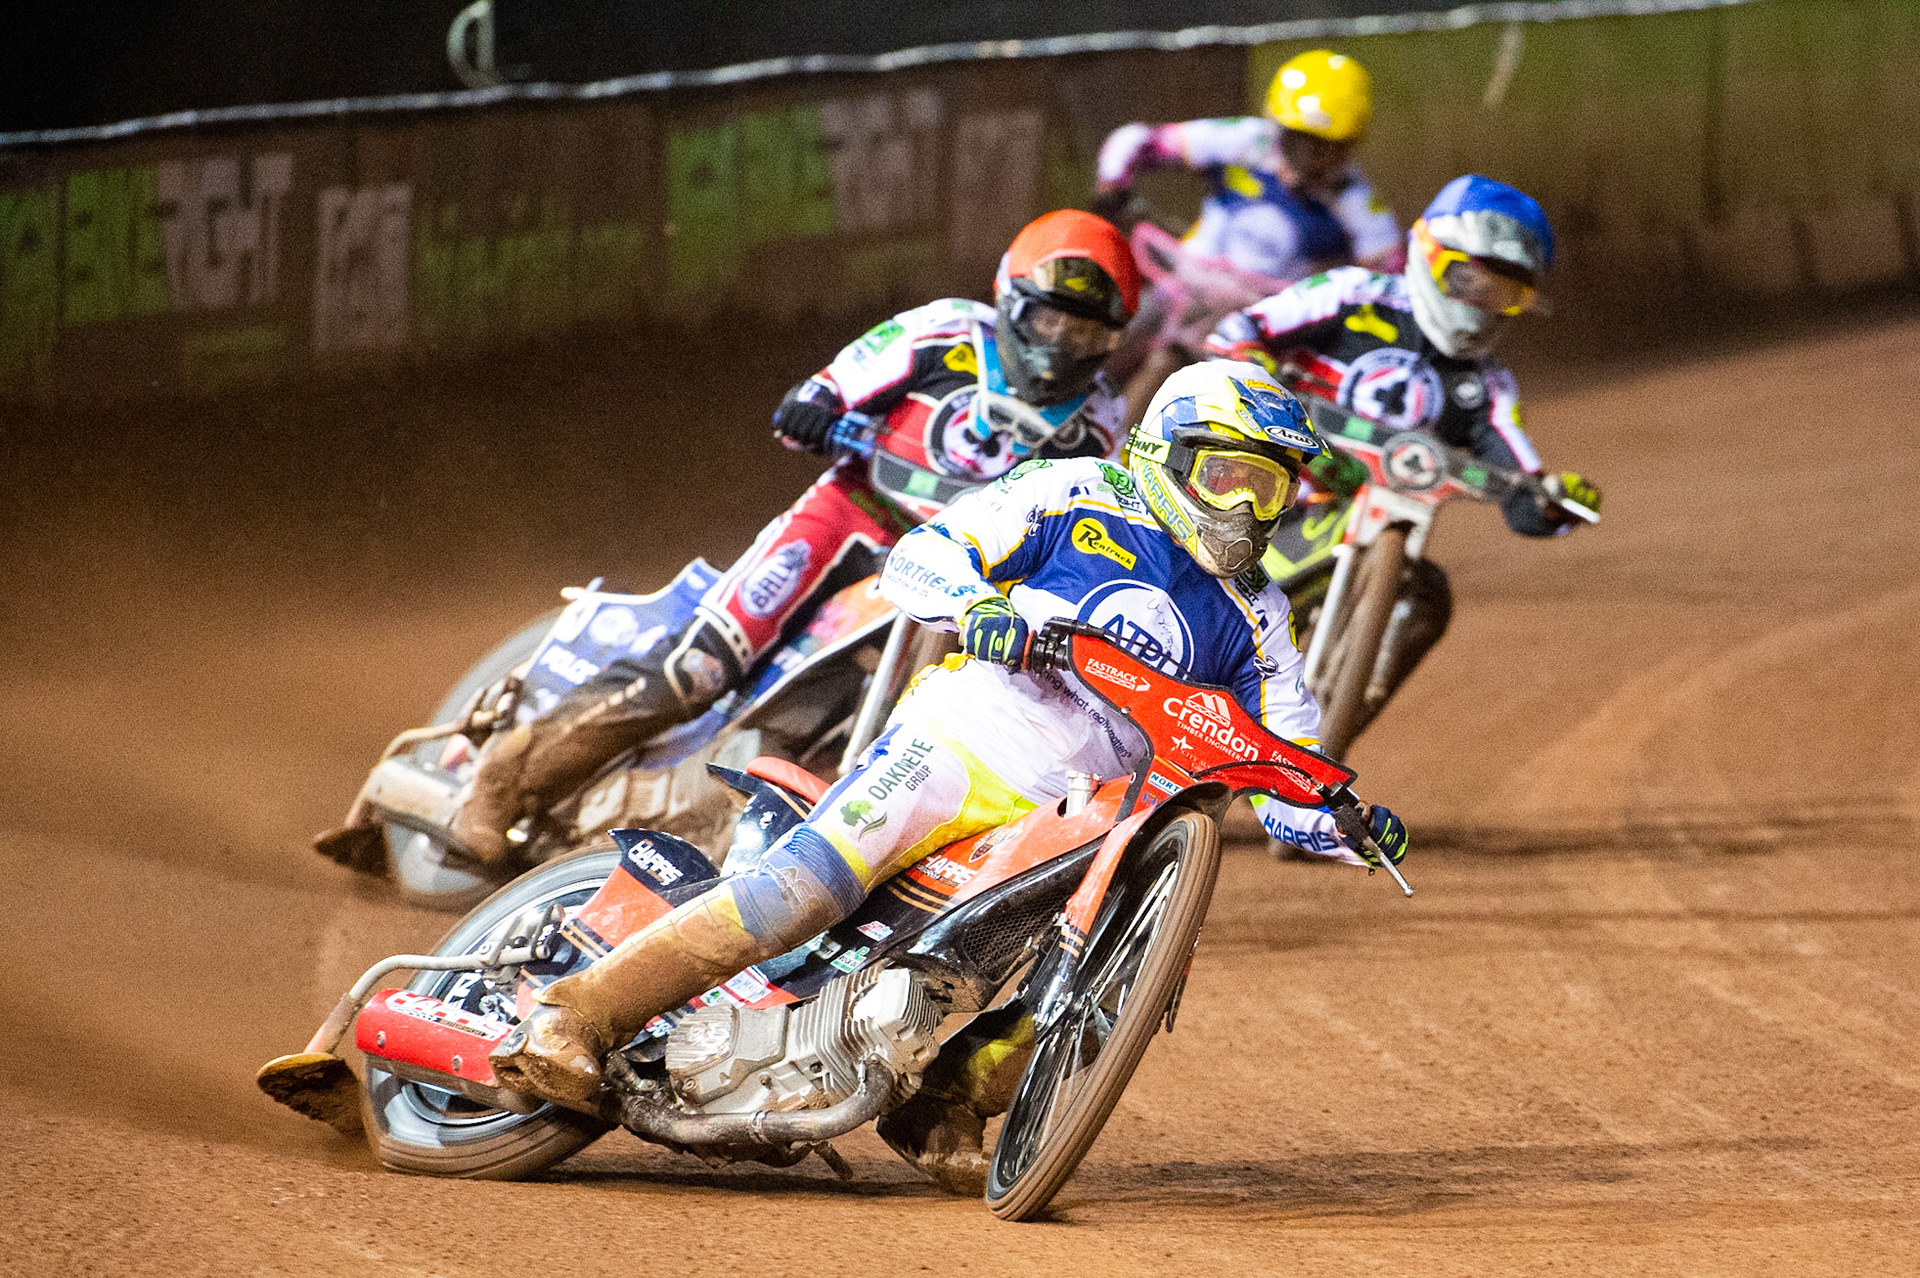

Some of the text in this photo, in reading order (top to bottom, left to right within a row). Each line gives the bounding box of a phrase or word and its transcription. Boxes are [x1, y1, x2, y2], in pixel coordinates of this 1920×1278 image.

[1266, 427, 1313, 446] Arai
[1079, 523, 1133, 566] Rentruck
[1086, 658, 1138, 684] FASTRACK
[1064, 685, 1090, 711] what
[1163, 697, 1259, 762] Crendon
[1177, 720, 1204, 740] TIMBER
[905, 765, 933, 791] GROUP
[1263, 812, 1340, 852] HARRIS
[628, 839, 685, 882] HARRIS
